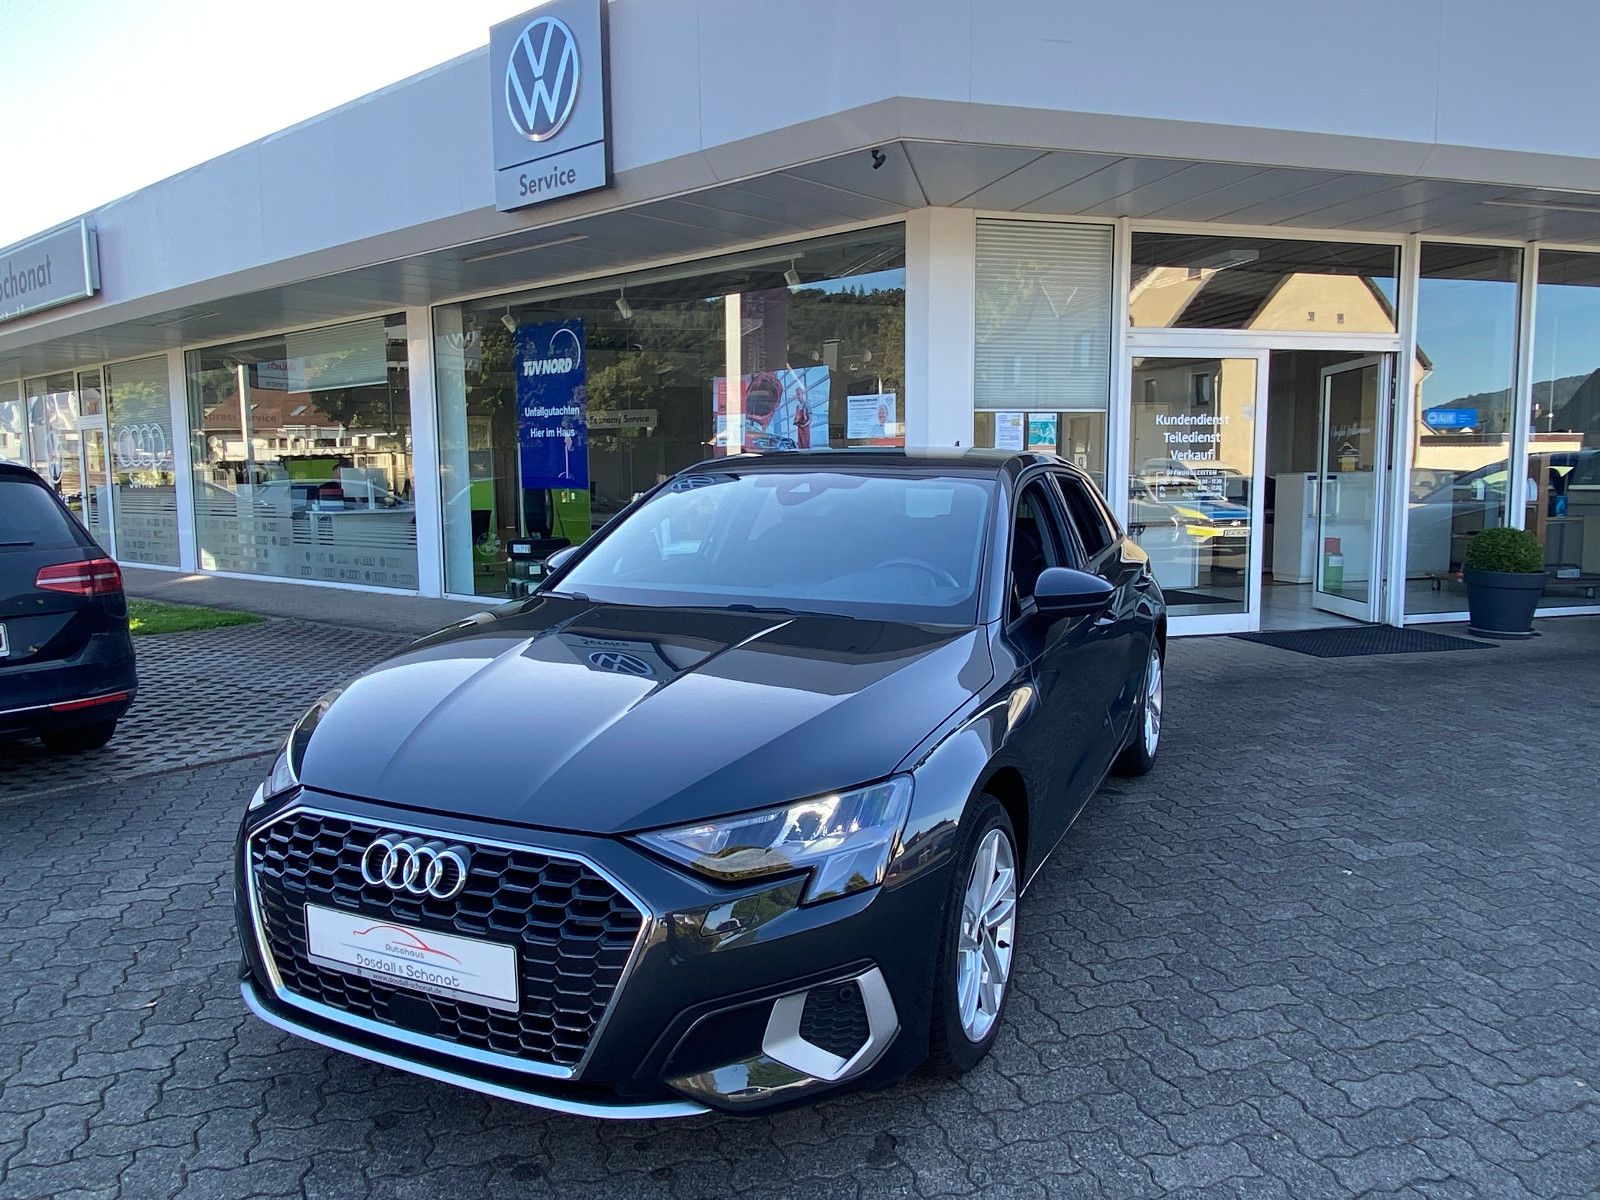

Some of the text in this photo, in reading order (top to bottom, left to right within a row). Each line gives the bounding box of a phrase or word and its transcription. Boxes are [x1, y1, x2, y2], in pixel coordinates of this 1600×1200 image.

[519, 166, 576, 197] Service
[542, 357, 573, 374] NORD
[524, 405, 580, 419] Unfallgutachten
[623, 414, 650, 423] Service
[1155, 413, 1230, 426] Kundendienst
[530, 427, 576, 438] Hier im Haus
[1163, 431, 1222, 443] Teiledienst
[1170, 449, 1214, 461] Verkauf
[385, 943, 425, 960] Autohaus
[356, 953, 396, 974] Dosdall
[406, 964, 460, 988] Schonat
